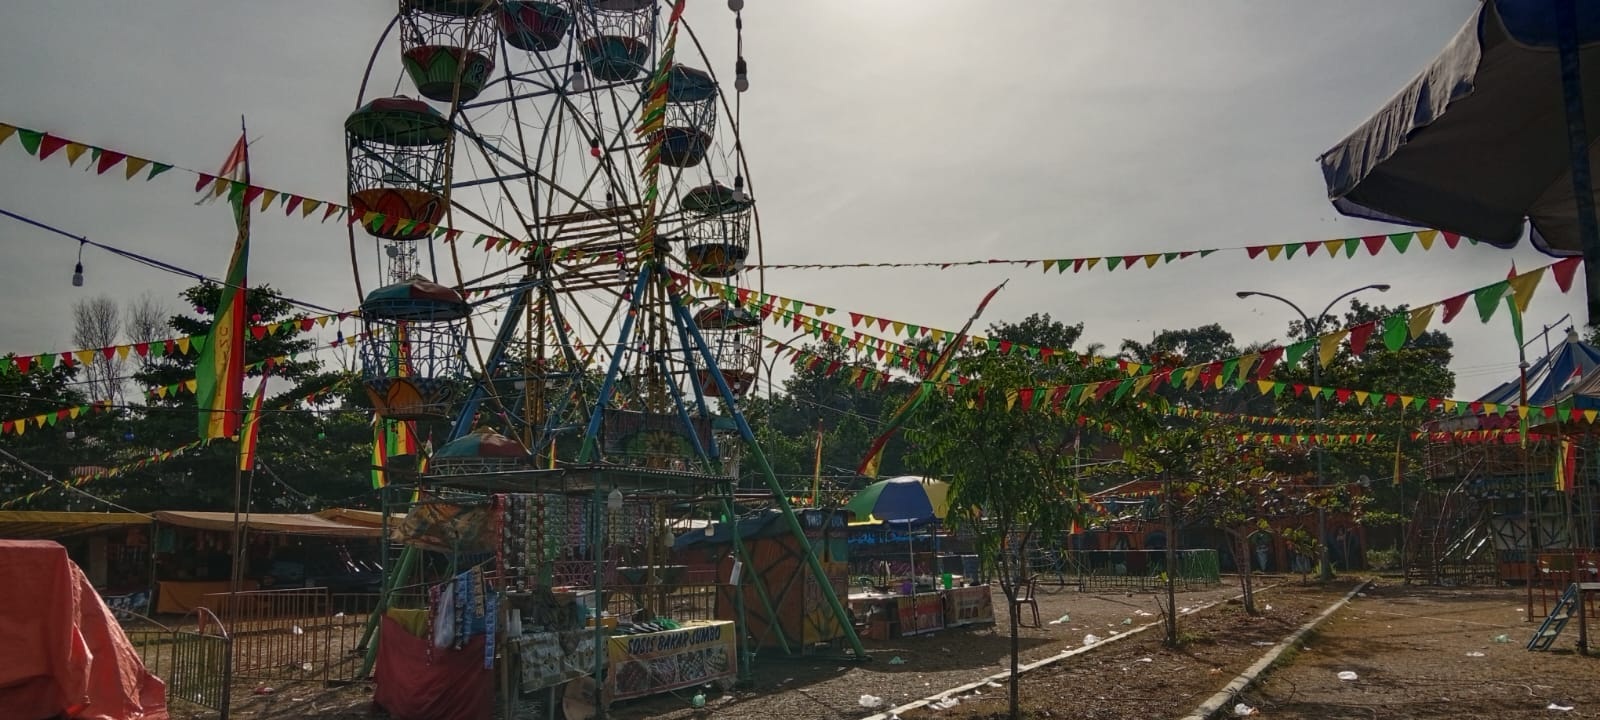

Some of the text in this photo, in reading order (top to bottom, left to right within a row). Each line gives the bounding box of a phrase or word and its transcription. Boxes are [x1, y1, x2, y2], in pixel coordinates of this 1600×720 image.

[628, 626, 721, 655] SOSIS BAKAR JUMBO
